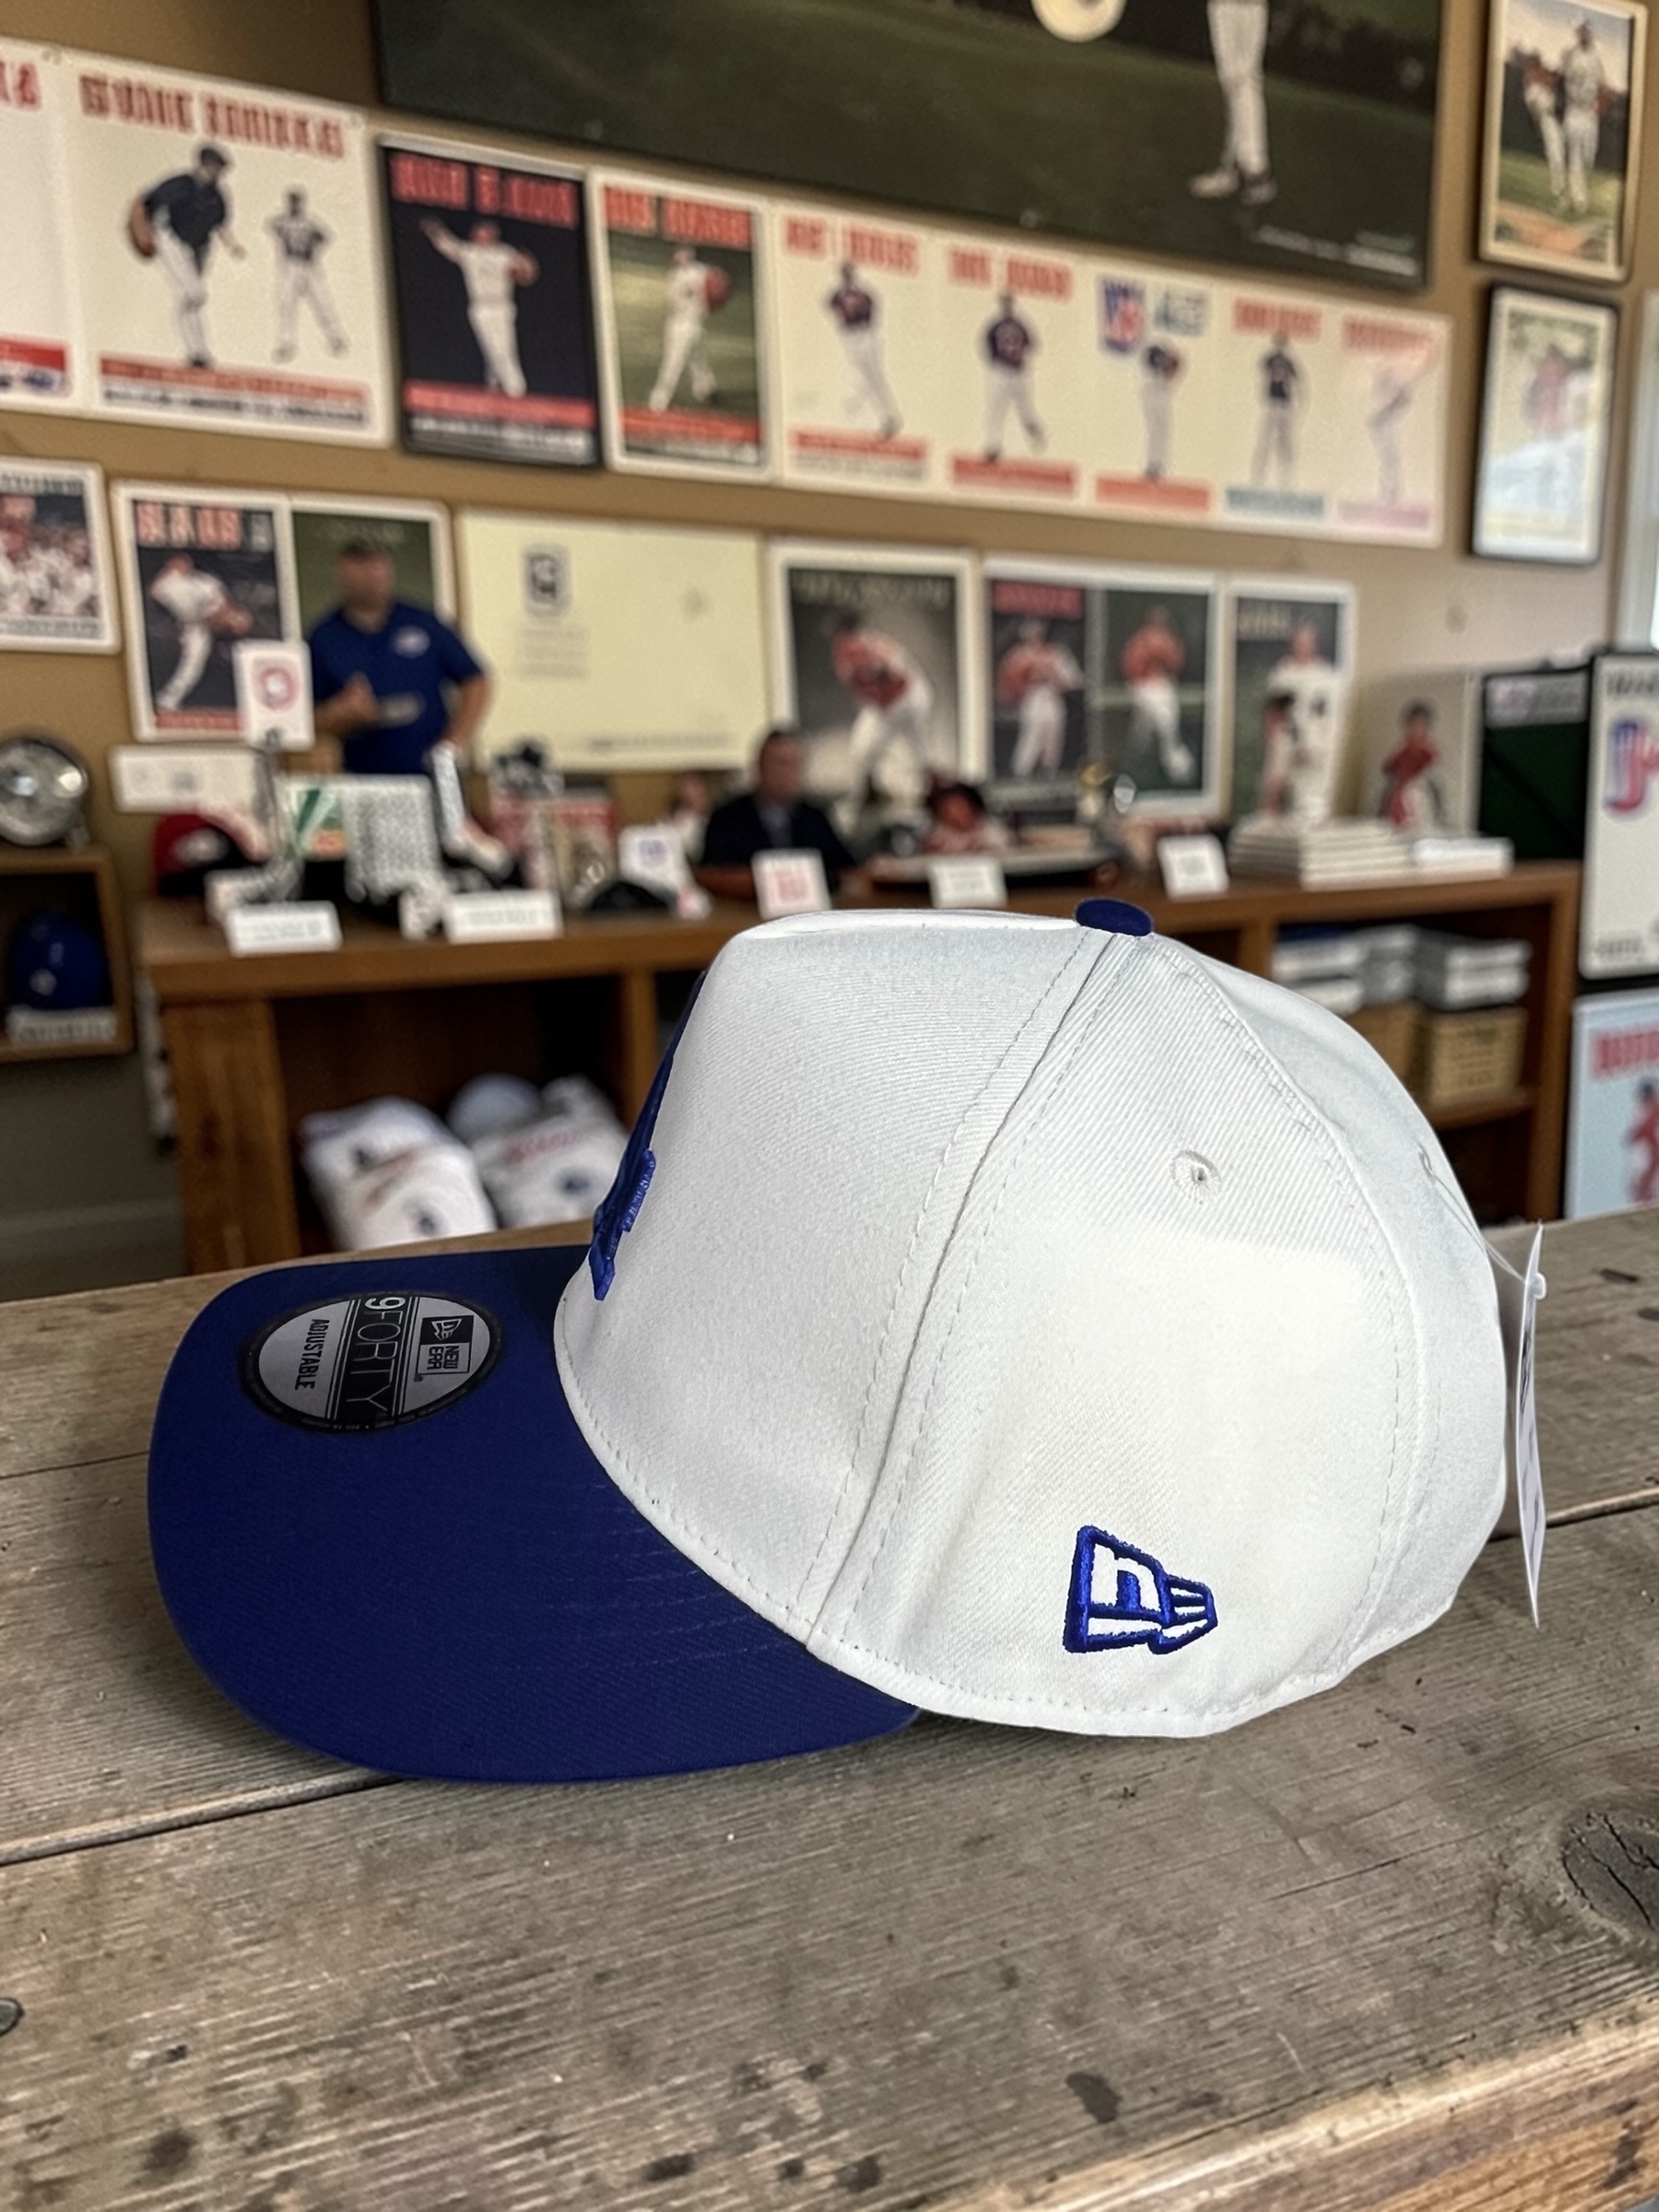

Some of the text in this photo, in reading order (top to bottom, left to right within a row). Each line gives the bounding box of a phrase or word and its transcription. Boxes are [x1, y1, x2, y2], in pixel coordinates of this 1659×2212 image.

[294, 1319, 330, 1391] ADJUSTABLE
[346, 1296, 406, 1412] 9FORTY
[427, 1346, 443, 1370] ERA
[443, 1346, 460, 1369] NEW
